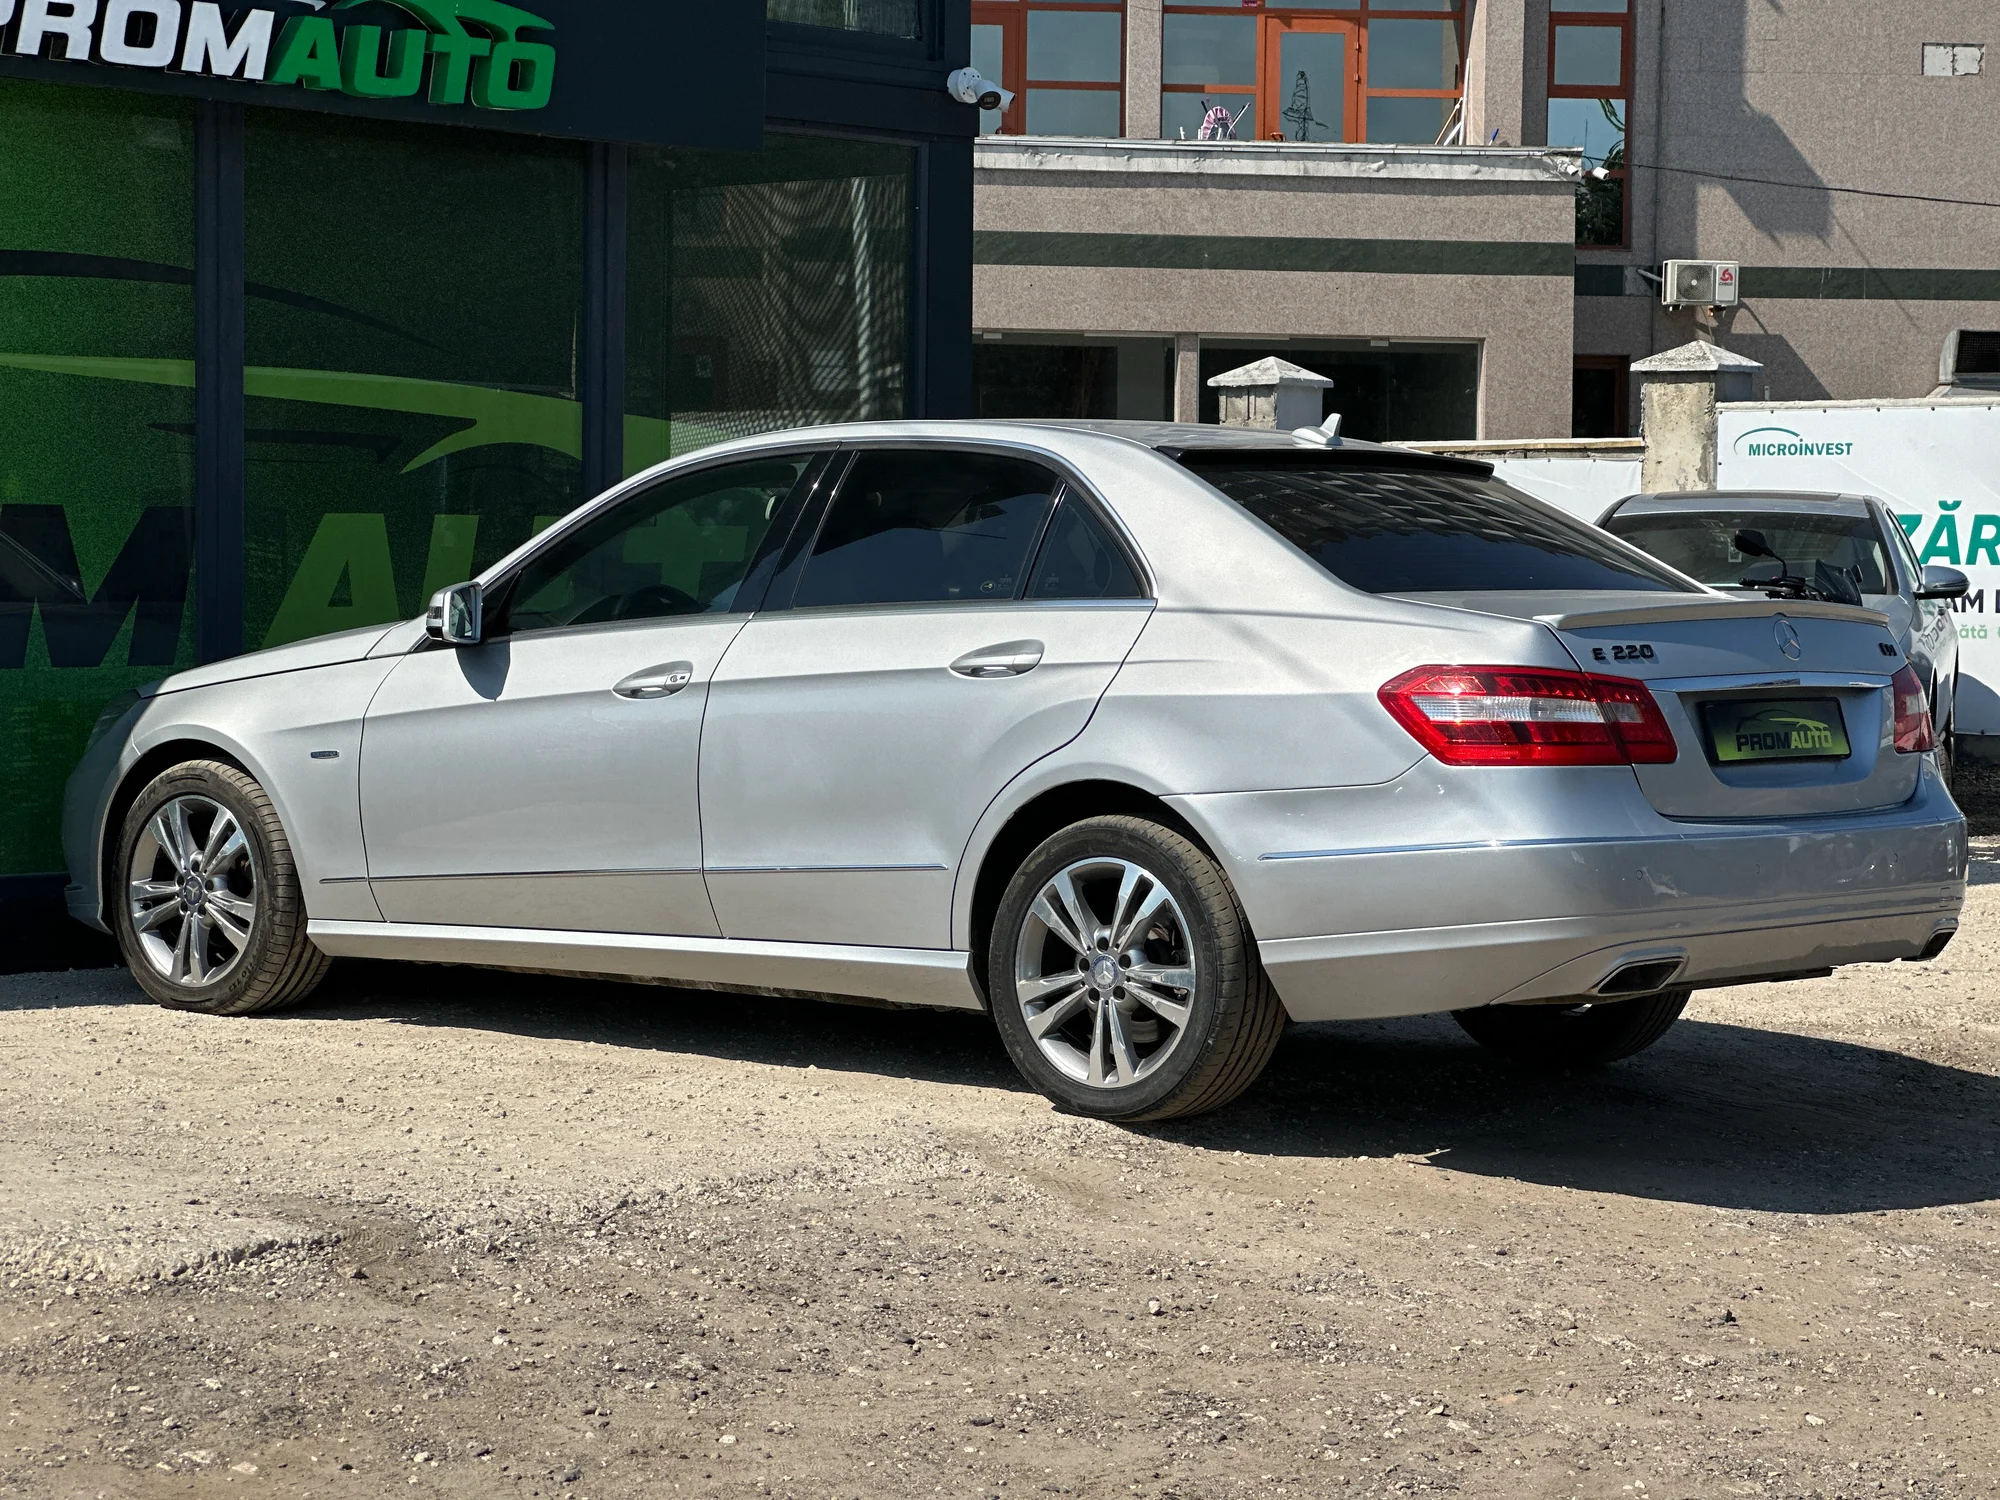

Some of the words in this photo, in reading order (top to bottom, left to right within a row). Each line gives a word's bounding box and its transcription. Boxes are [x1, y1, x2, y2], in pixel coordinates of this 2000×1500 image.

[0, 0, 556, 110] ROMAUTO
[1592, 648, 1606, 660] E
[1611, 644, 1654, 660] 220
[1736, 730, 1832, 752] PROMAUTO
